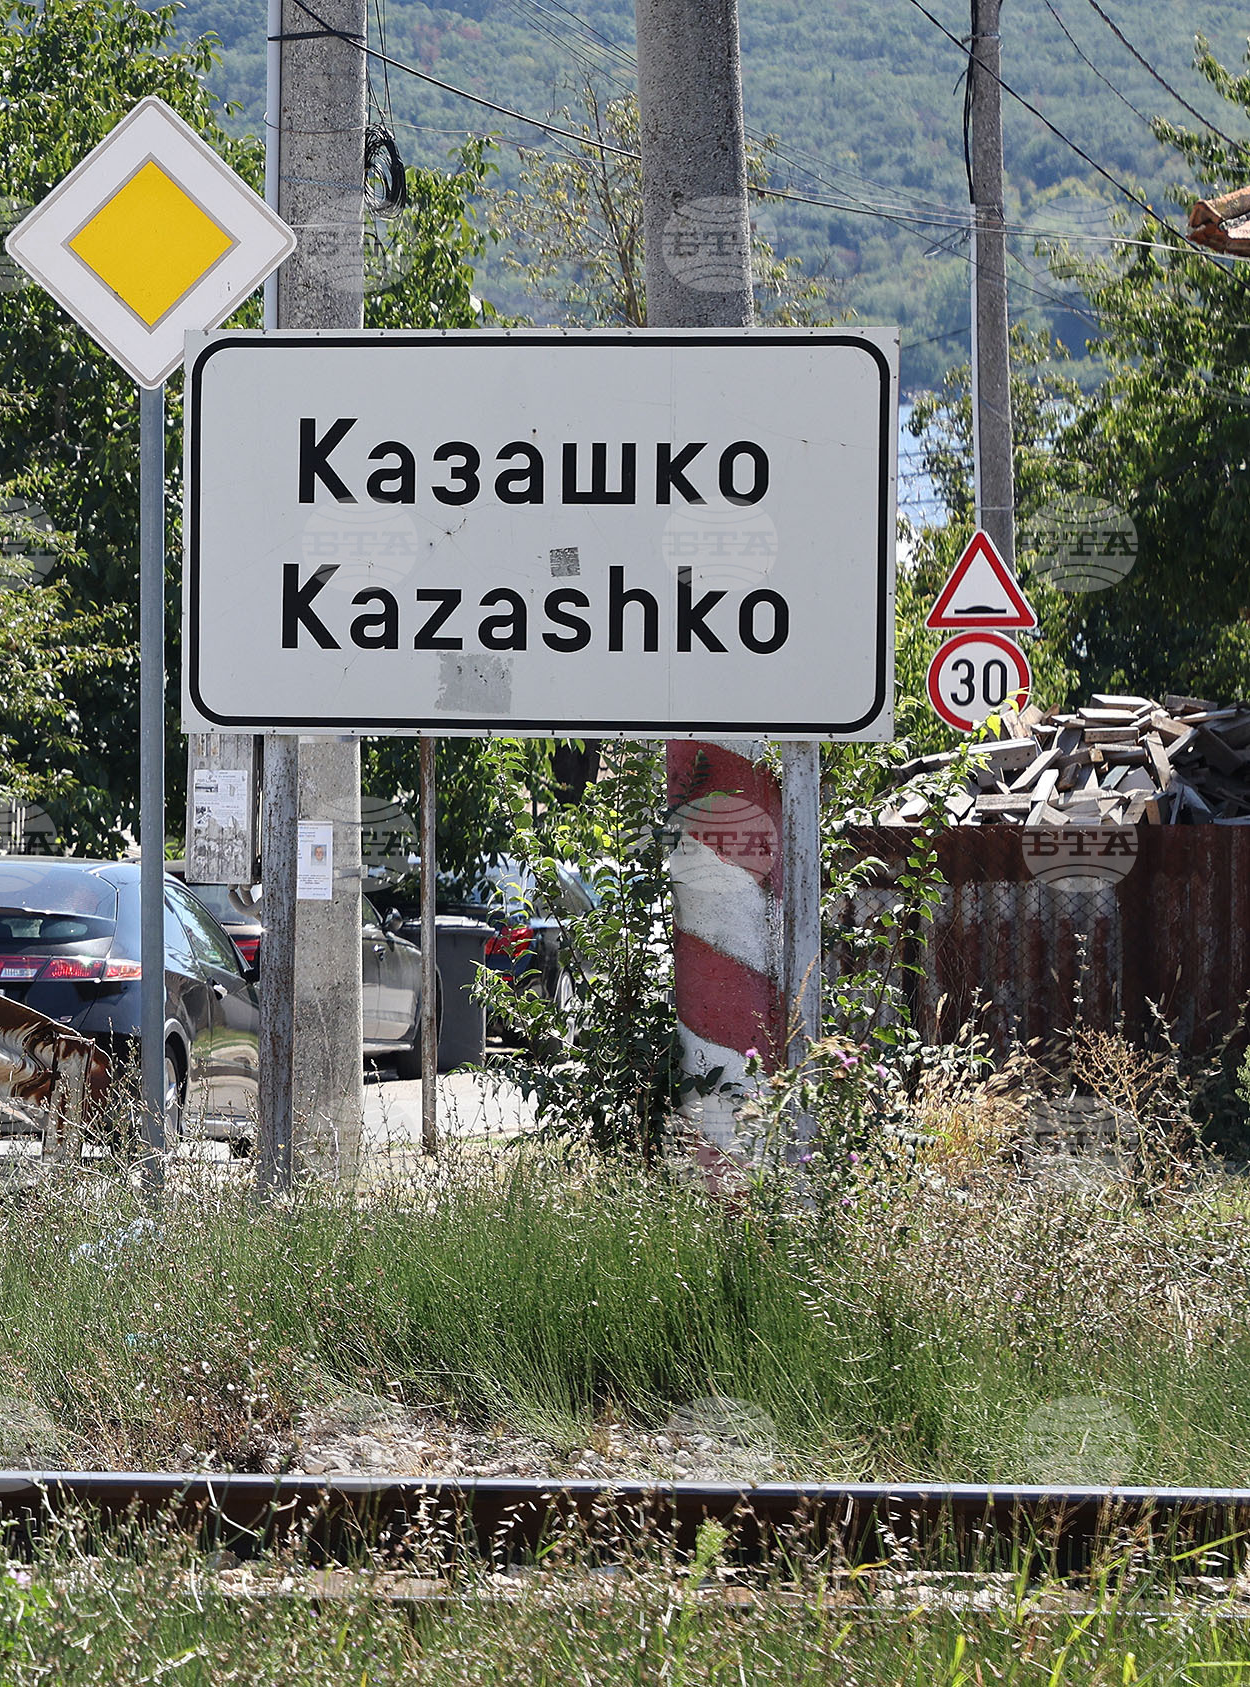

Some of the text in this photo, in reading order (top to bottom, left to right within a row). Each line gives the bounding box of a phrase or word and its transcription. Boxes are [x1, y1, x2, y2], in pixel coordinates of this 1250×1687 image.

[298, 417, 769, 507] Казашко
[281, 563, 790, 655] Kazashko
[950, 659, 1008, 707] 30
